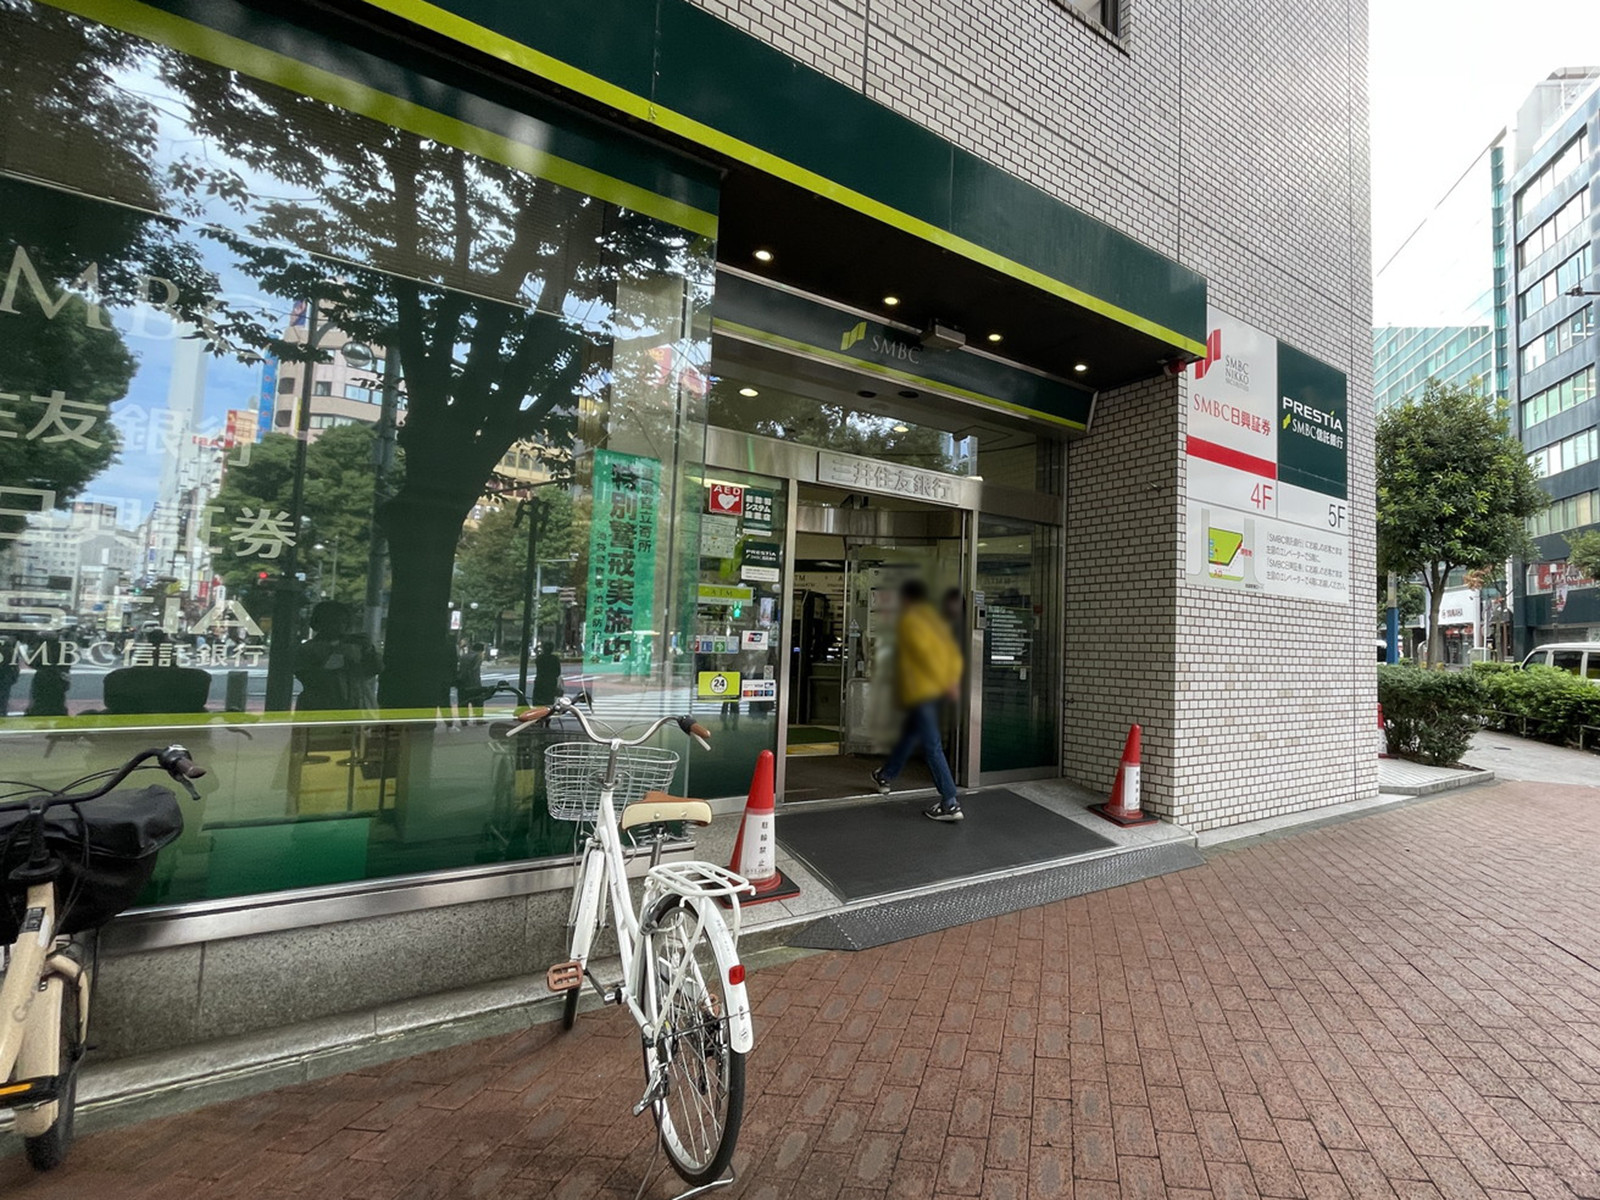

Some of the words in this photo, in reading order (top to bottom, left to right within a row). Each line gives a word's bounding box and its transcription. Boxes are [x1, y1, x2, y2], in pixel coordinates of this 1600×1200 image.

[870, 335, 919, 364] SMBC
[1225, 355, 1249, 375] SMBC
[1225, 368, 1249, 385] NIKKO
[1193, 393, 1271, 436] SMBC日興証券
[1282, 396, 1343, 432] PRESTIA
[1292, 418, 1343, 450] SMBC信託銀行
[714, 484, 742, 497] AED
[831, 459, 950, 499] 三井住友銀行
[1250, 483, 1273, 511] 4F
[1328, 503, 1345, 528] 5F
[713, 679, 725, 688] 24
